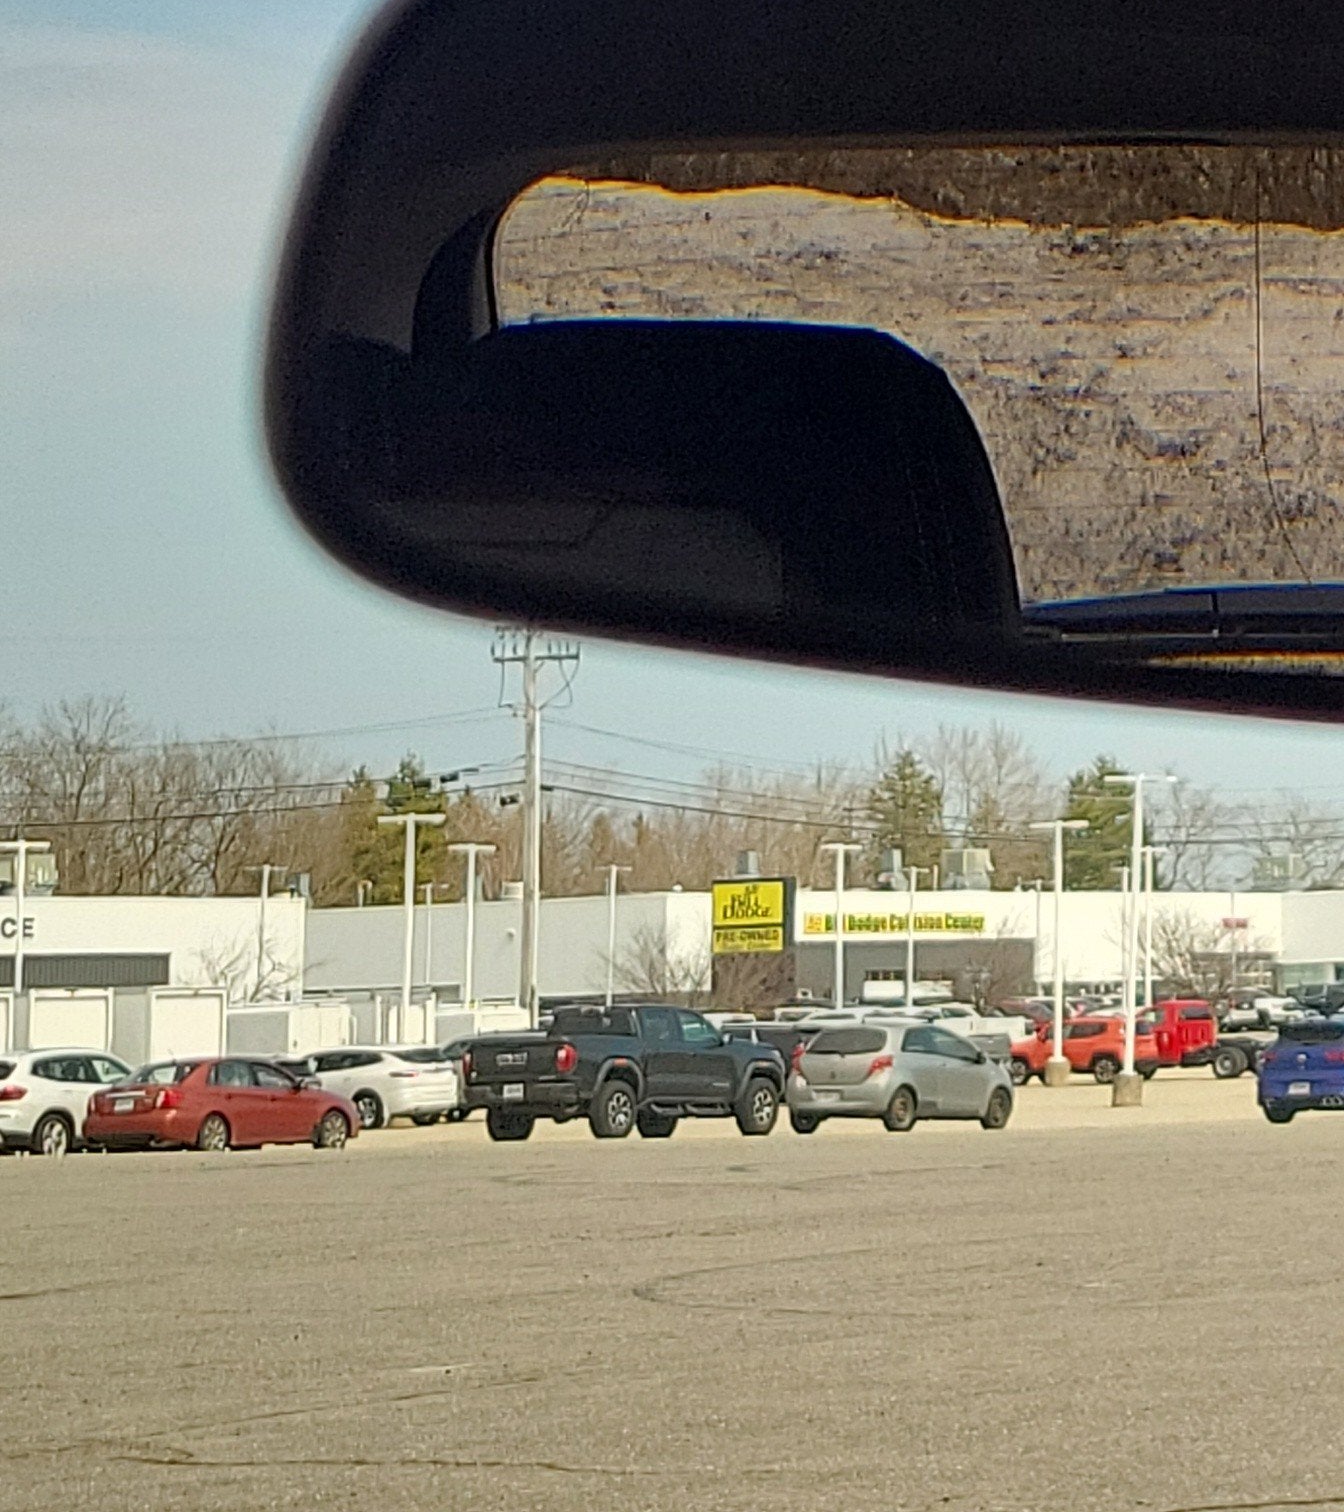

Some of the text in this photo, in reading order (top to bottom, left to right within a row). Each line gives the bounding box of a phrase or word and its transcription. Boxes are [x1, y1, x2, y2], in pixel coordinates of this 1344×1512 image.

[0, 916, 35, 939] CE
[848, 912, 888, 933] Dodge
[944, 912, 985, 932] Center
[716, 929, 780, 942] PRE-OWNED
